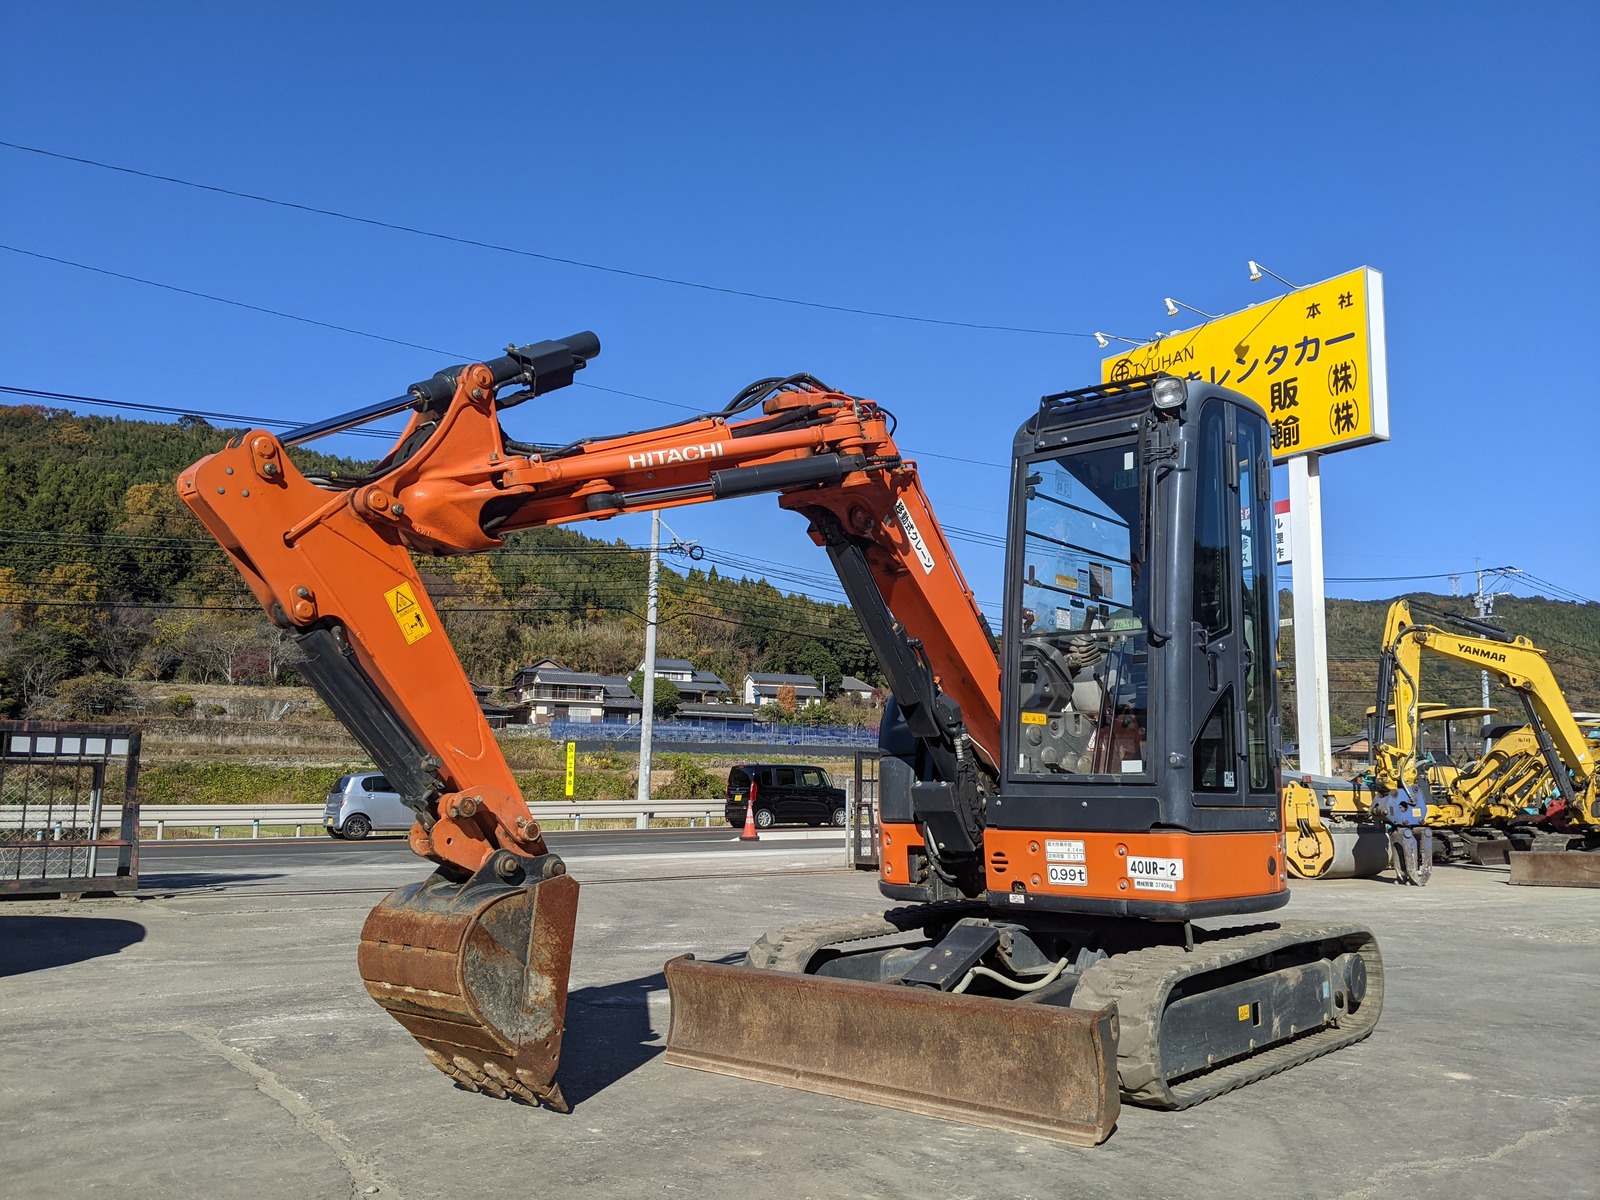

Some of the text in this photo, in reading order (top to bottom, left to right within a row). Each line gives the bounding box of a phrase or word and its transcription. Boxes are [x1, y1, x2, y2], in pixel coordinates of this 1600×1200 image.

[628, 442, 724, 470] HITACHI
[895, 500, 933, 569] 移動式クレーン
[1457, 643, 1507, 663] YANMAR
[1050, 868, 1085, 882] 0.99t
[1130, 860, 1177, 876] 40UR-2
